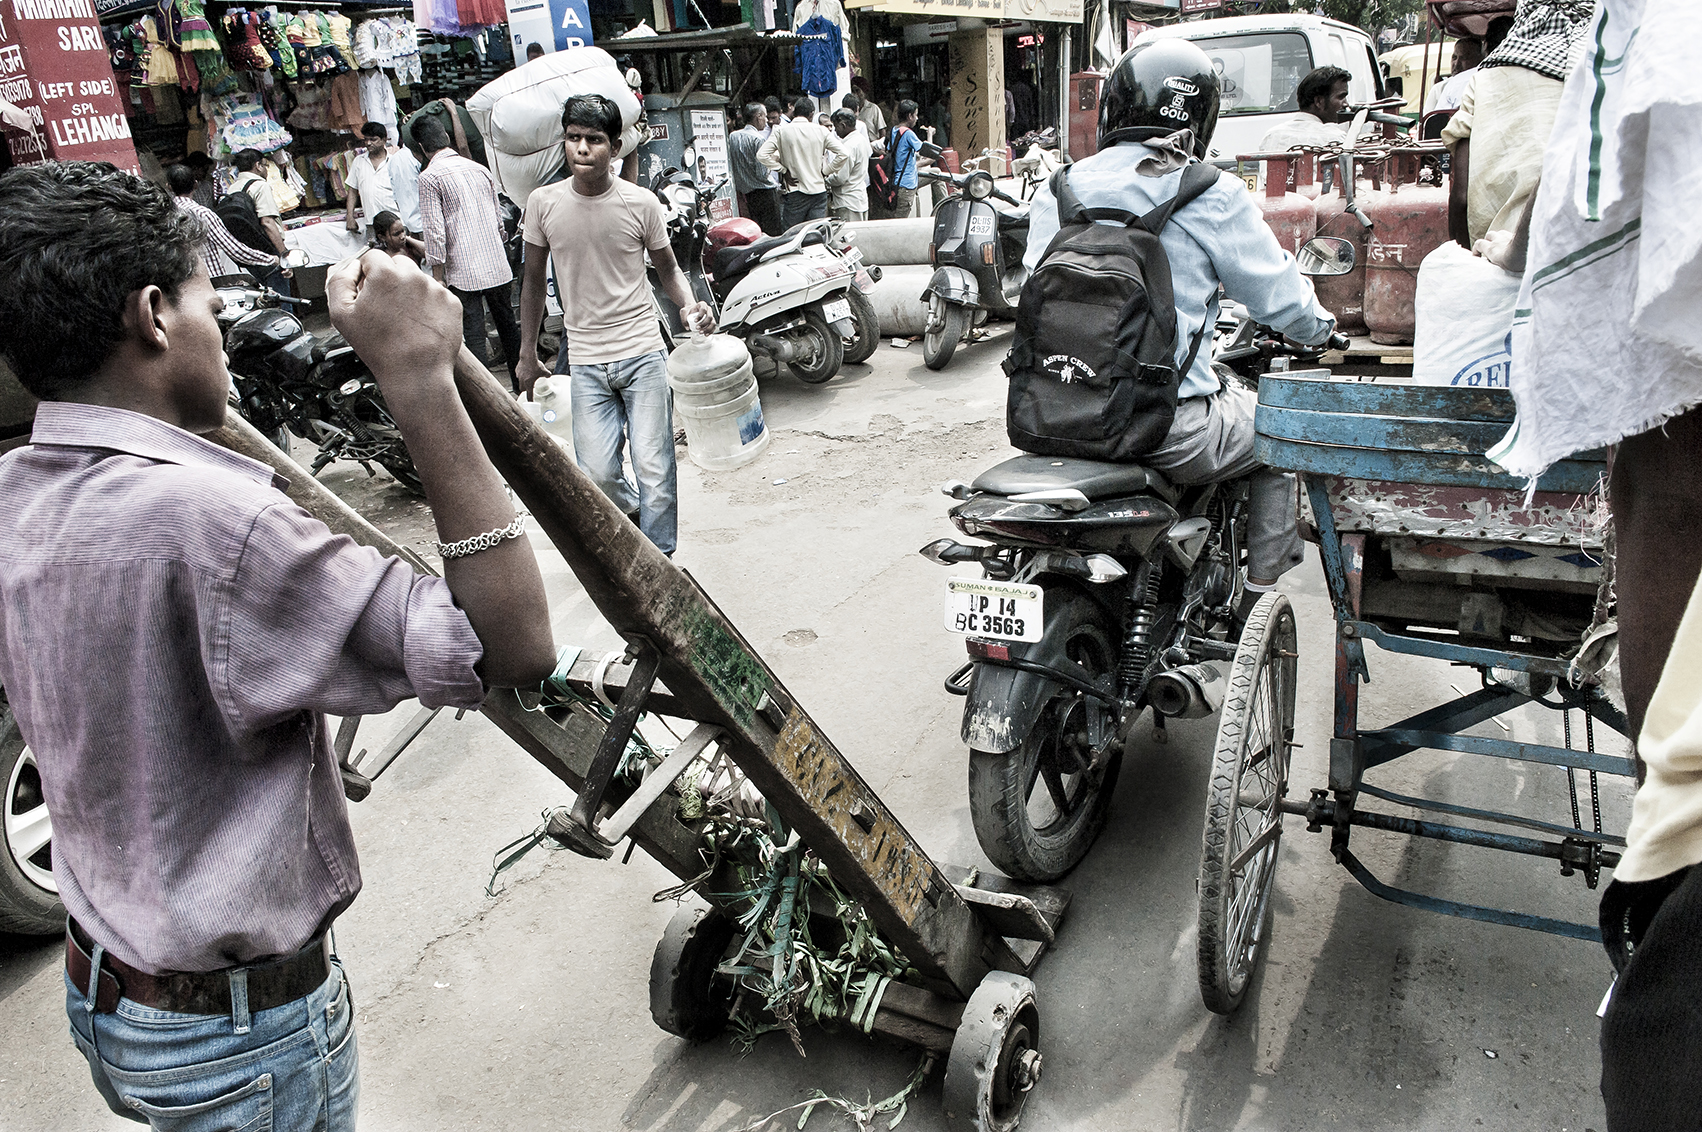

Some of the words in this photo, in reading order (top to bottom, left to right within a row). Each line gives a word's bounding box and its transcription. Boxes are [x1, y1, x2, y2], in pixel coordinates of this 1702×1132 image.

[57, 26, 103, 51] SARI
[79, 77, 115, 97] SIDE)
[1167, 80, 1196, 93] QUALITY
[1160, 106, 1189, 121] GOLD
[51, 114, 132, 147] LEHANGA
[970, 225, 990, 234] 4937
[750, 290, 781, 302] Activa
[1042, 354, 1069, 368] ASPEN
[1070, 356, 1097, 378] CREW
[955, 582, 986, 591] SUMAN
[994, 586, 1028, 595] BAJAJ
[969, 594, 989, 613] UP
[999, 598, 1016, 617] 14
[982, 615, 1025, 637] 3563
